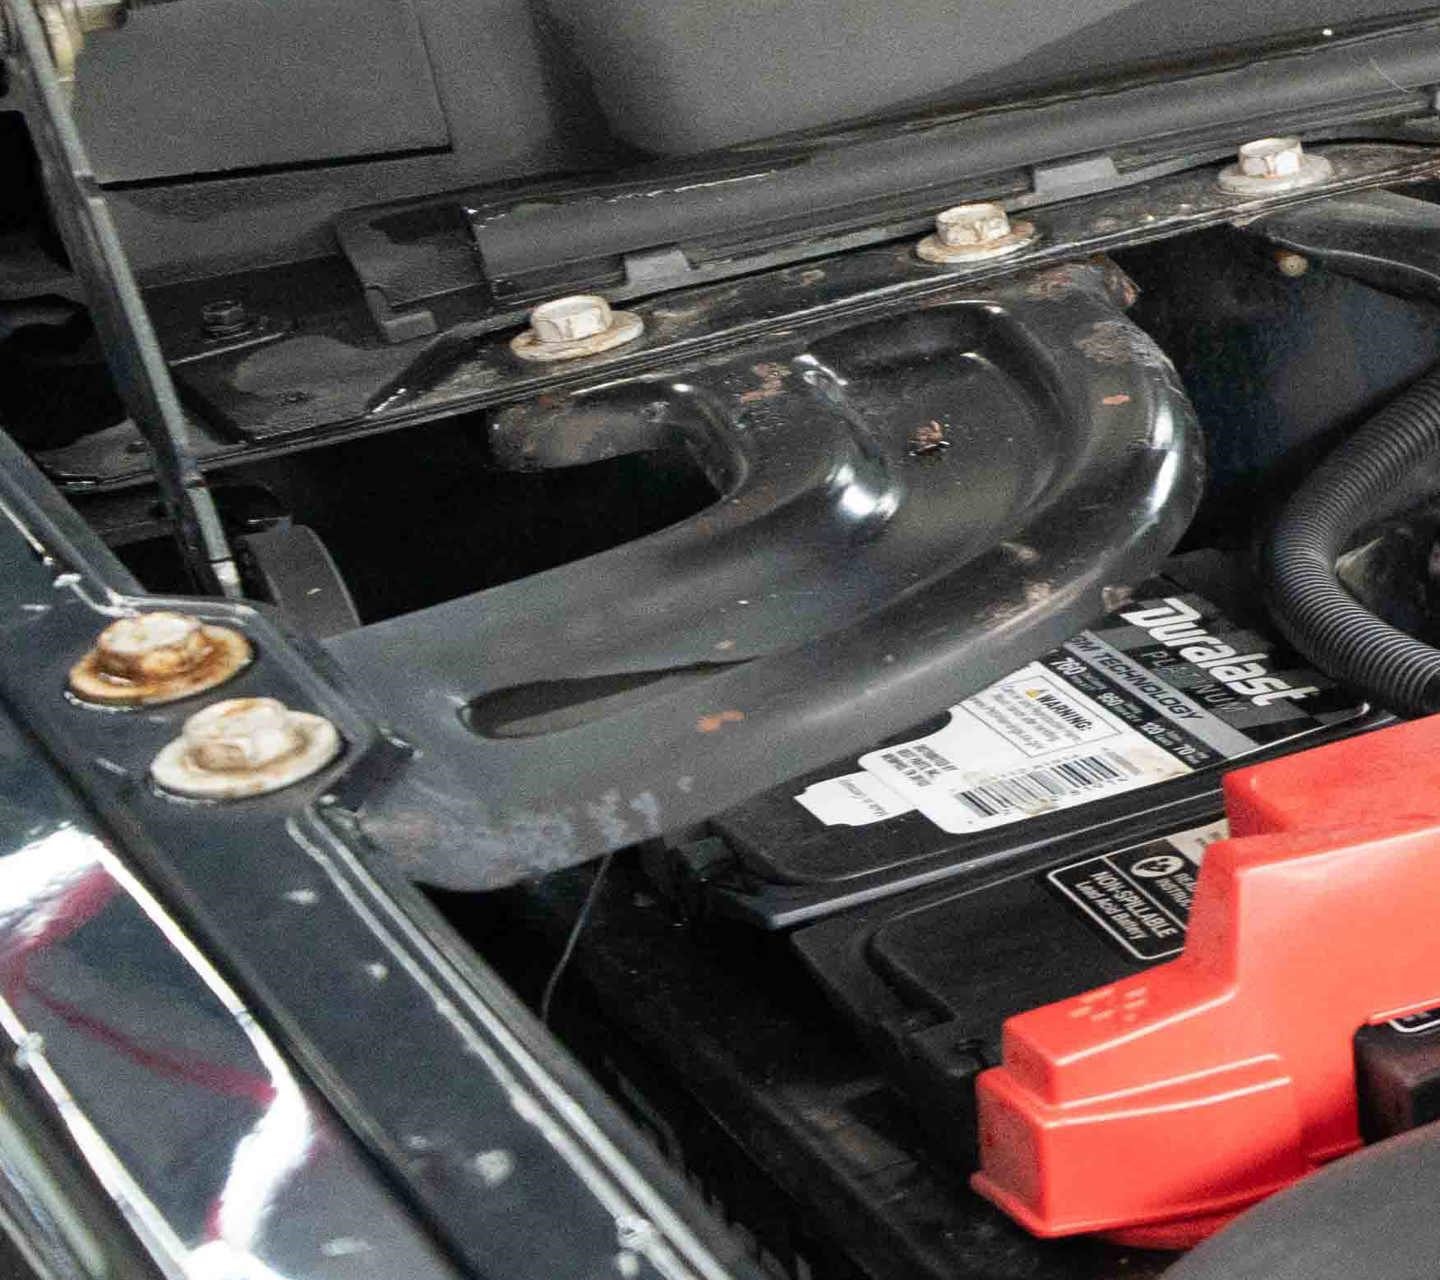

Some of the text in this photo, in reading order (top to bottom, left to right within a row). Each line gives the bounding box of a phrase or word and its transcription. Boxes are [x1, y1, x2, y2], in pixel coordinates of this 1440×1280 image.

[1119, 597, 1321, 707] Duralast
[1141, 649, 1248, 713] PLATINUM
[1035, 694, 1093, 732] WARNING:
[1092, 651, 1203, 720] TECHNOLOGY
[1074, 879, 1105, 902] Lead
[1089, 870, 1180, 939] NON-SPILLABLE
